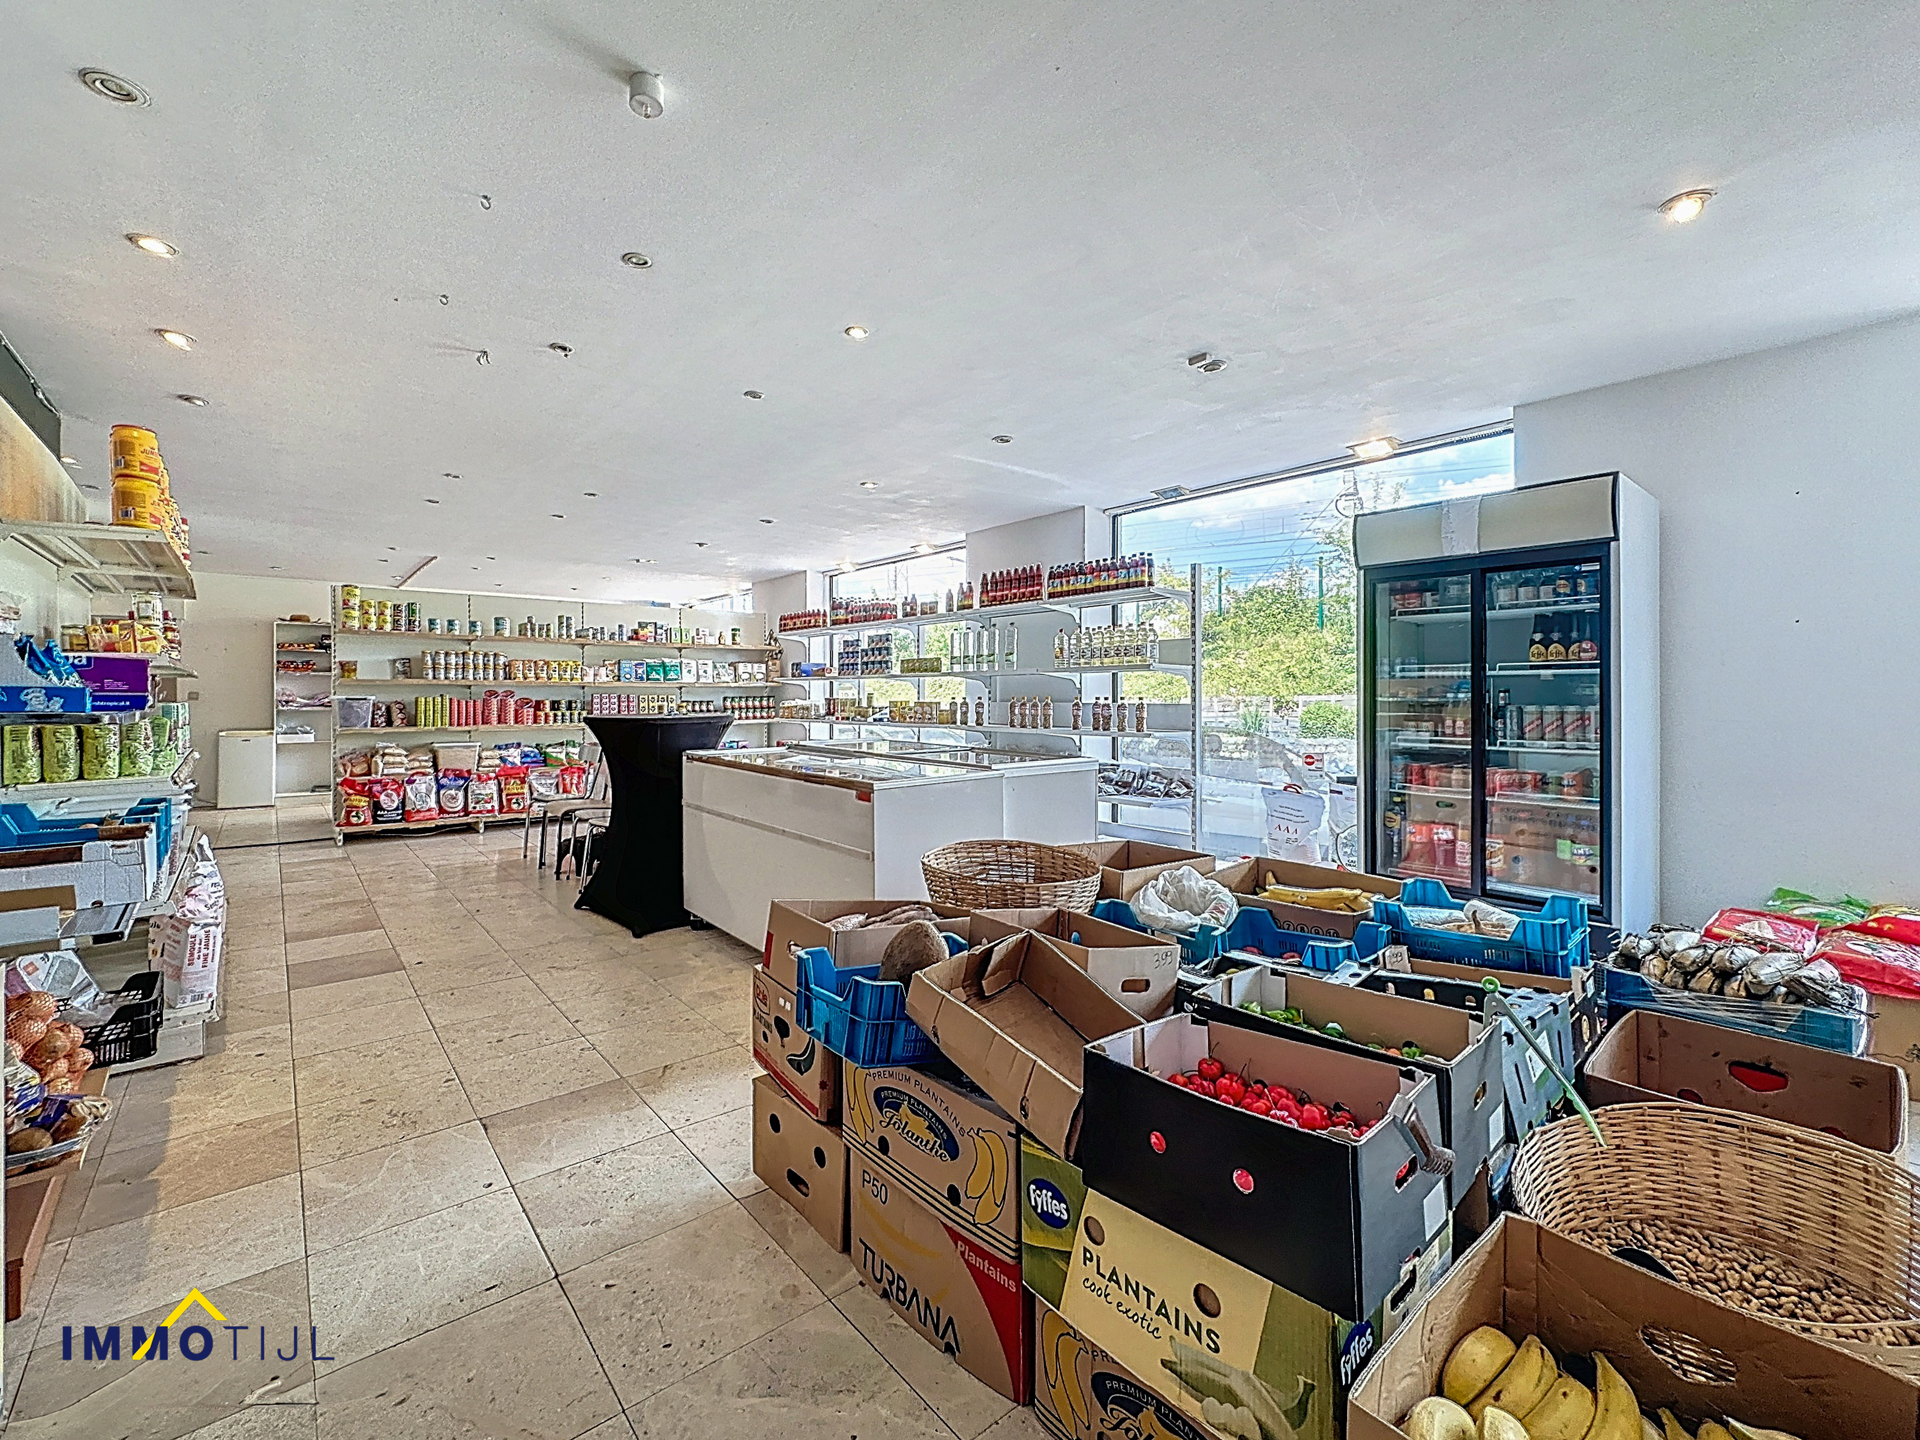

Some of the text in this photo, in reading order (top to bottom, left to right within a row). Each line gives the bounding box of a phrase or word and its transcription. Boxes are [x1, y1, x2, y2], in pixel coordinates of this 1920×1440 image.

[140, 448, 158, 457] JUM
[188, 934, 196, 966] SEMOULE
[872, 1070, 966, 1136] PREMIUM PLANTAINS
[880, 1090, 948, 1140] PREMIUM PLANTAINS
[880, 1109, 949, 1162] Jolanthe
[862, 1169, 888, 1206] P50
[1028, 1184, 1068, 1221] fyffes
[957, 1240, 1017, 1293] Plantains
[859, 1238, 960, 1354] TURBANA
[1082, 1246, 1220, 1354] PLANTAINS
[1082, 1277, 1162, 1339] cook exotic
[1092, 1350, 1120, 1364] PR
[1340, 1327, 1373, 1386] fyffes
[1106, 1380, 1157, 1408] PREMIUM
